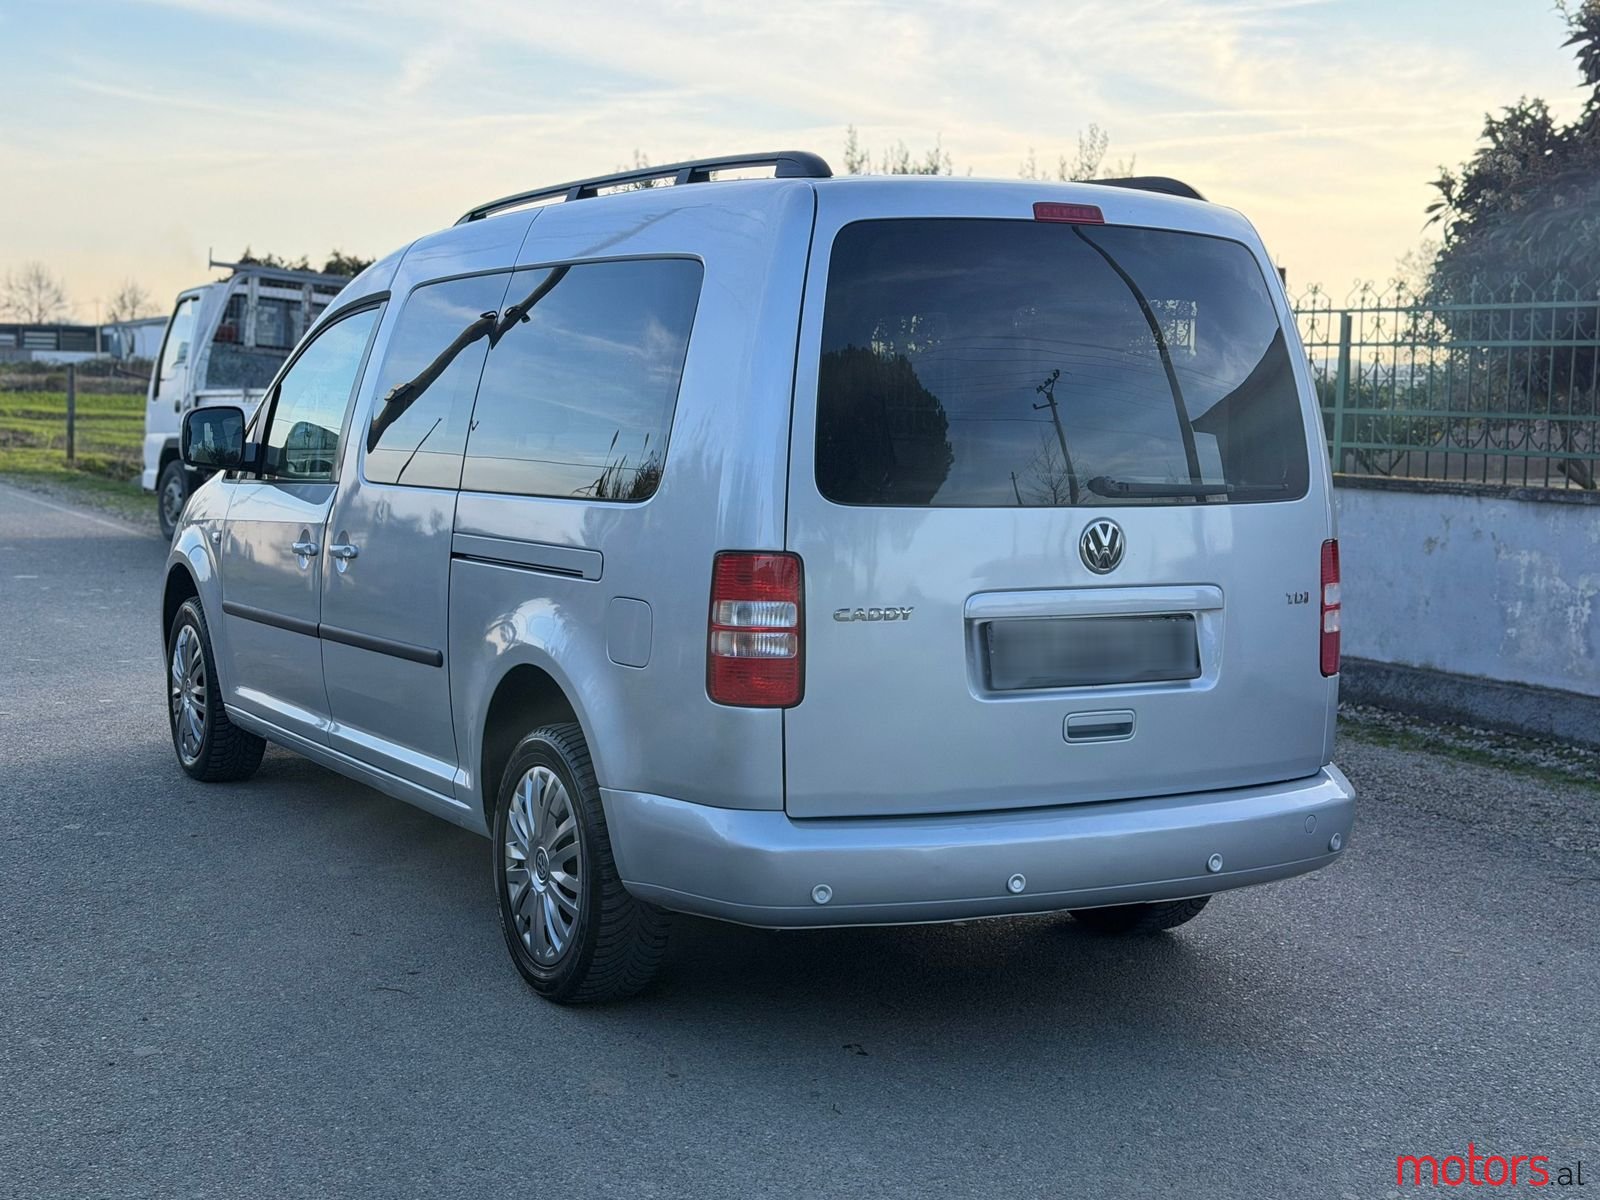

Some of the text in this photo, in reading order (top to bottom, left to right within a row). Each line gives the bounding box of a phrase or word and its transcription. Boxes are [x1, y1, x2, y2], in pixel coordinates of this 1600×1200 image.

[1081, 520, 1124, 571] VW
[1285, 591, 1309, 605] TDI
[833, 606, 914, 622] CADDY
